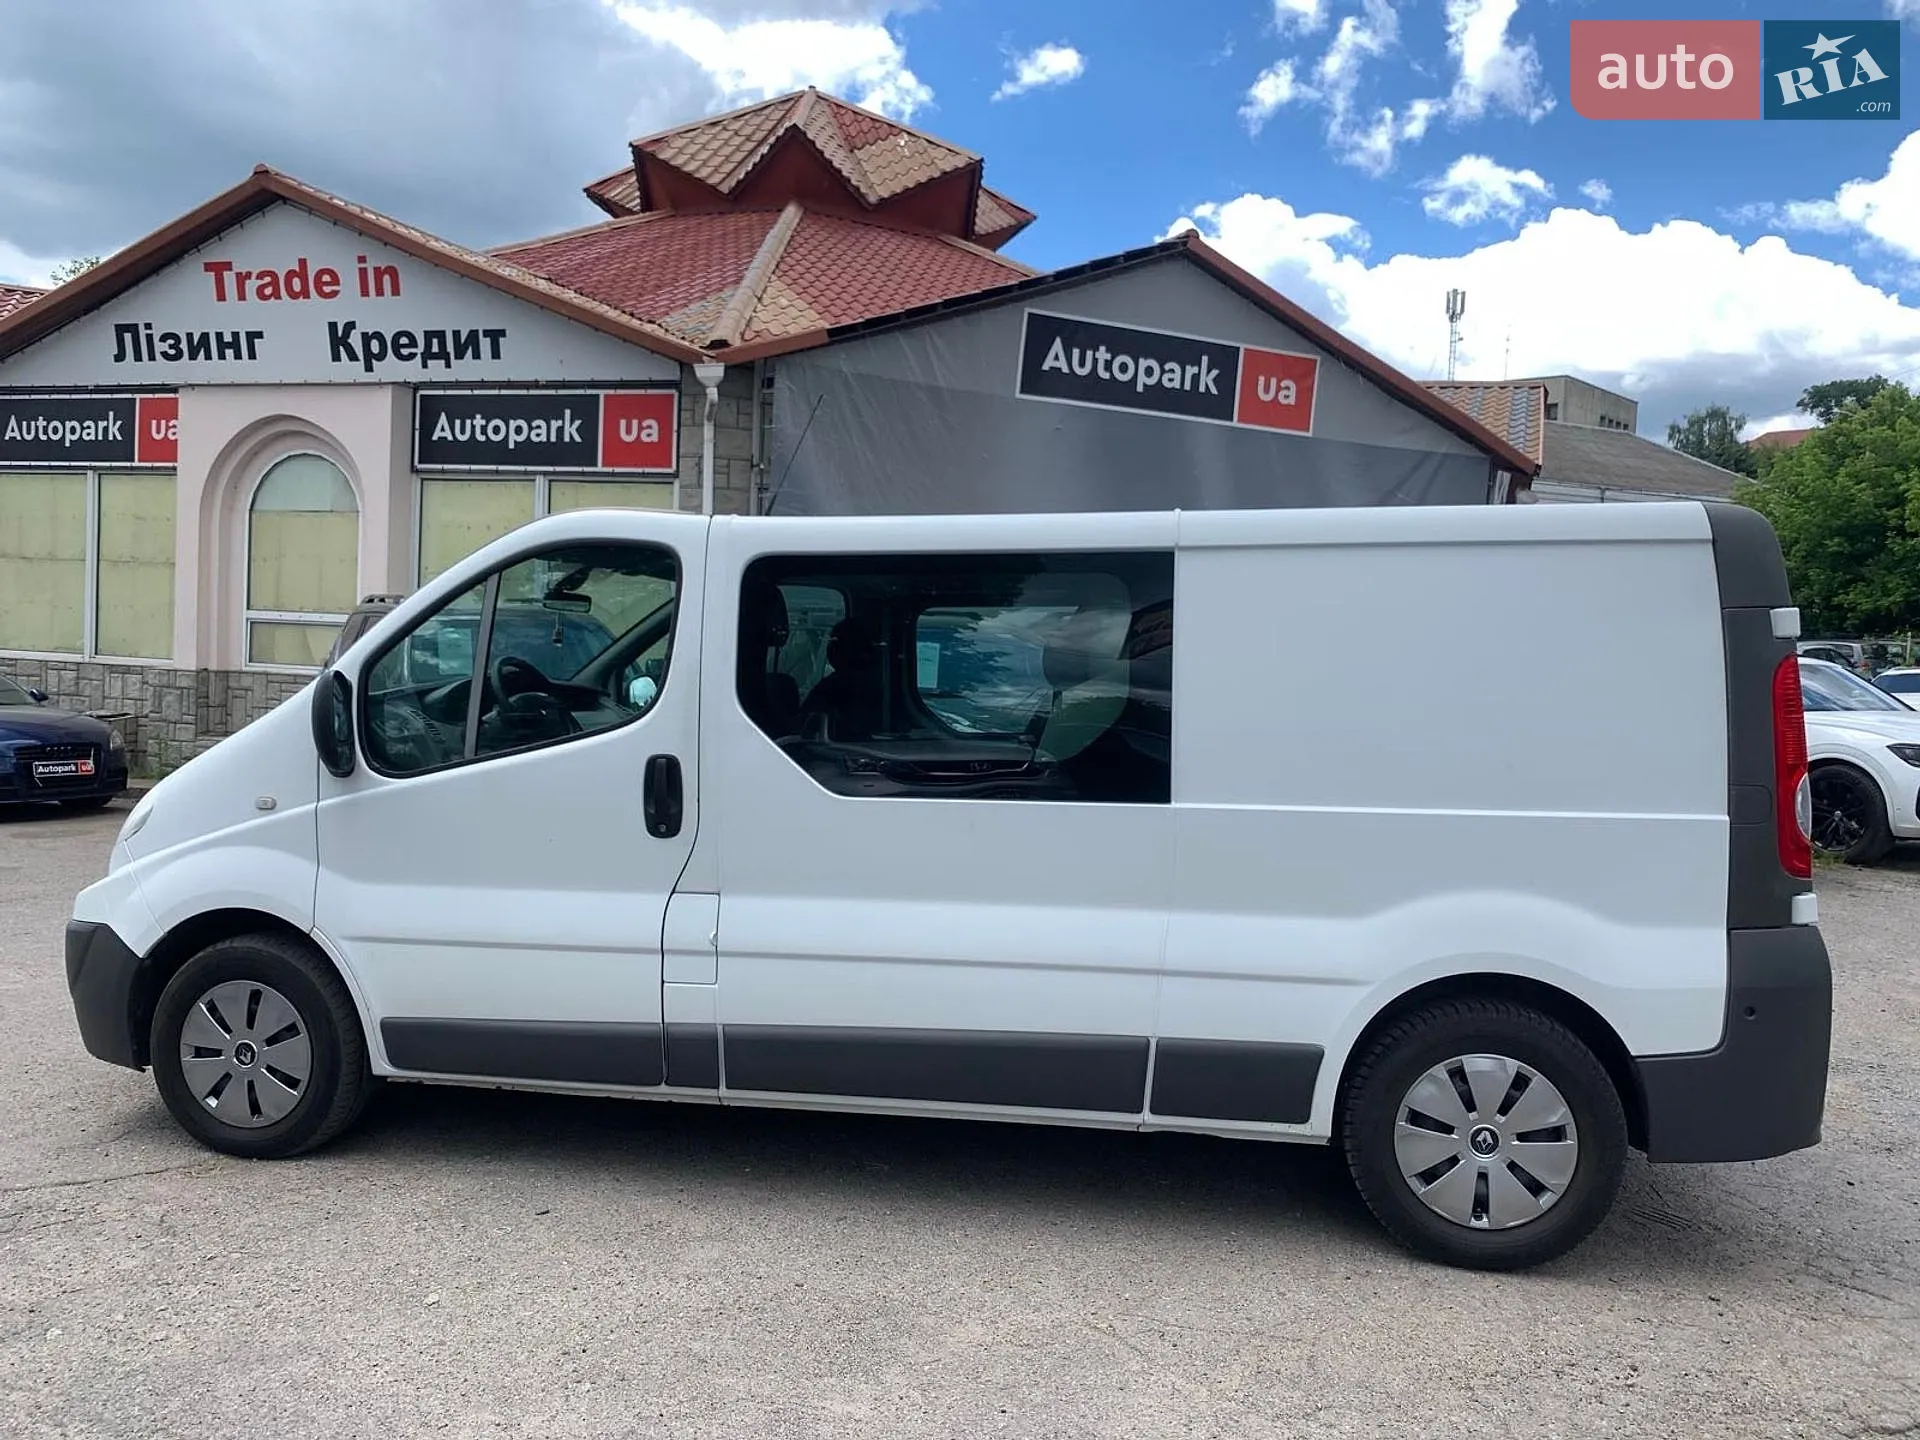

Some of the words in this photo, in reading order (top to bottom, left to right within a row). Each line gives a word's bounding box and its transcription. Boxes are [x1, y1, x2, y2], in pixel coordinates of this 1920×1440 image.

[203, 258, 341, 302] Trade
[358, 255, 401, 298] in
[112, 322, 265, 364] Лізинг
[327, 320, 508, 373] Кредит
[1041, 336, 1220, 396] Autopark
[1256, 374, 1297, 406] ua
[4, 411, 124, 448] Autopark
[431, 408, 583, 450] Autopark
[619, 418, 660, 443] ua
[37, 763, 77, 773] Autopark
